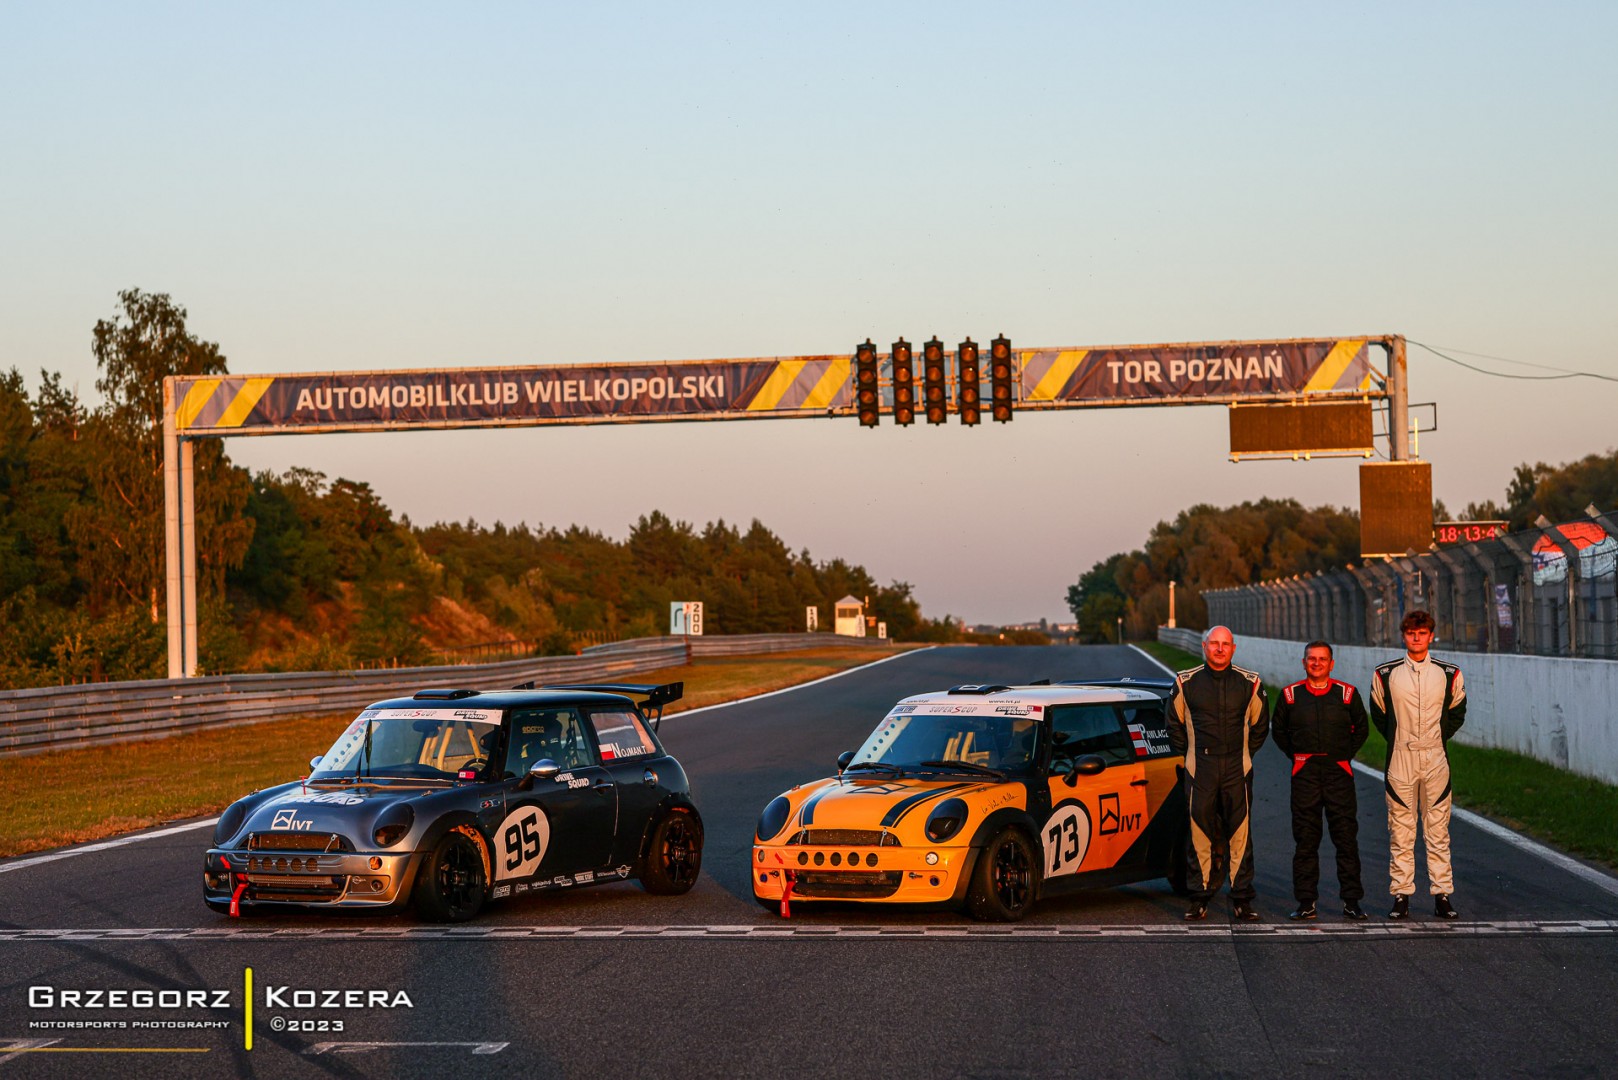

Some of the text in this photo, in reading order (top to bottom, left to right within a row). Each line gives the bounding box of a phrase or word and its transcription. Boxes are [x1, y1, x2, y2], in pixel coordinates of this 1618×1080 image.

[1107, 350, 1283, 384] TOR POZNAŃ
[296, 375, 725, 411] AUTOMOBILKLUB WIELKOPOLSKI
[1440, 525, 1505, 543] 18:13:4
[568, 778, 590, 789] SQUAD
[291, 820, 314, 831] IVT
[1120, 813, 1142, 833] IVT
[505, 812, 541, 872] 95
[1049, 813, 1079, 872] 73
